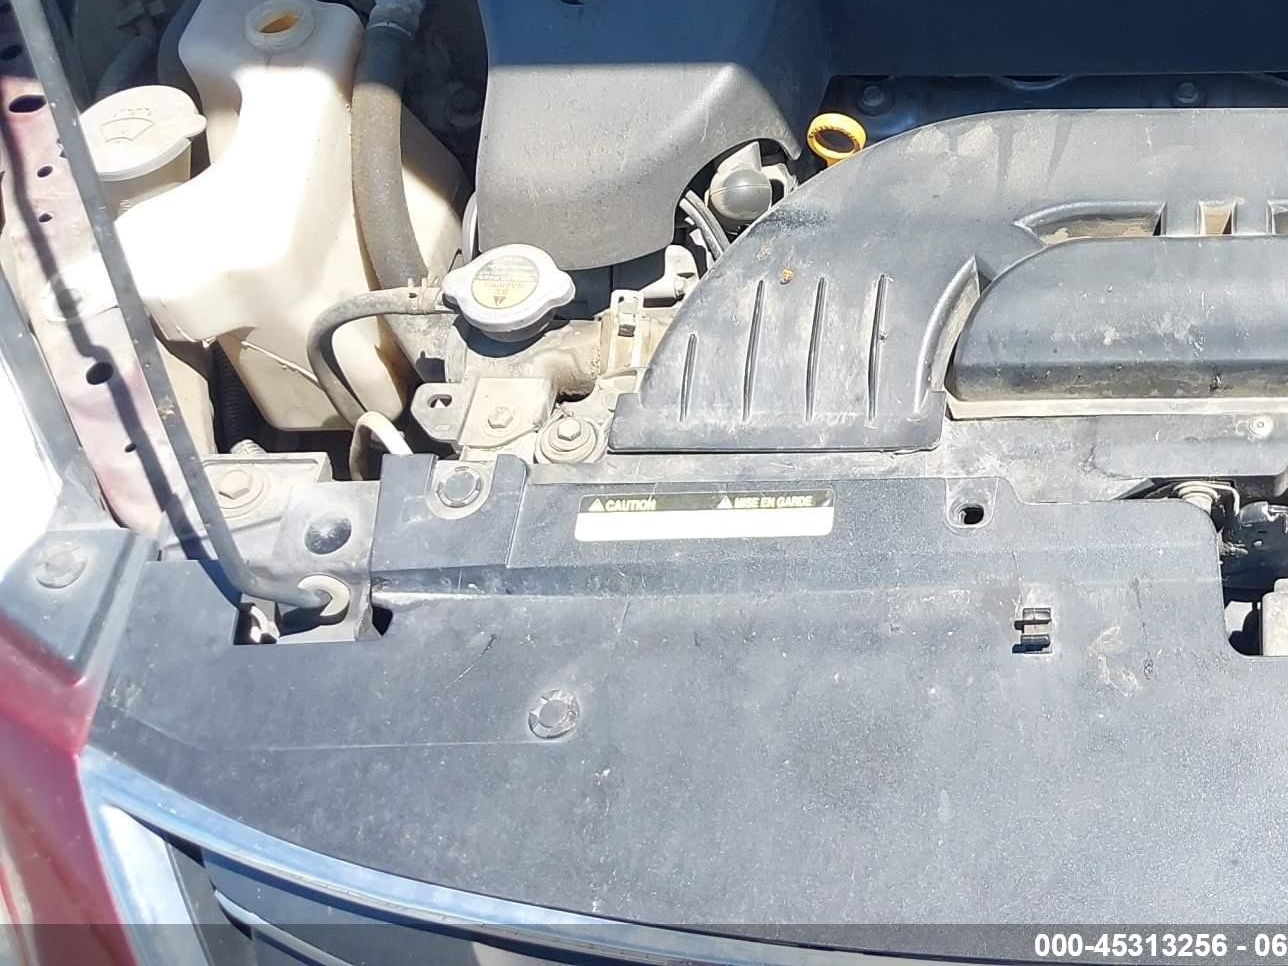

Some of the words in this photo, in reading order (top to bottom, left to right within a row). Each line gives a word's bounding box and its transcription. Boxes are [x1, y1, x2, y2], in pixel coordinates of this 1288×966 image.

[605, 498, 657, 512] CAUTION
[734, 496, 760, 509] MISE
[760, 496, 776, 508] EN
[776, 495, 815, 508] GARDE
